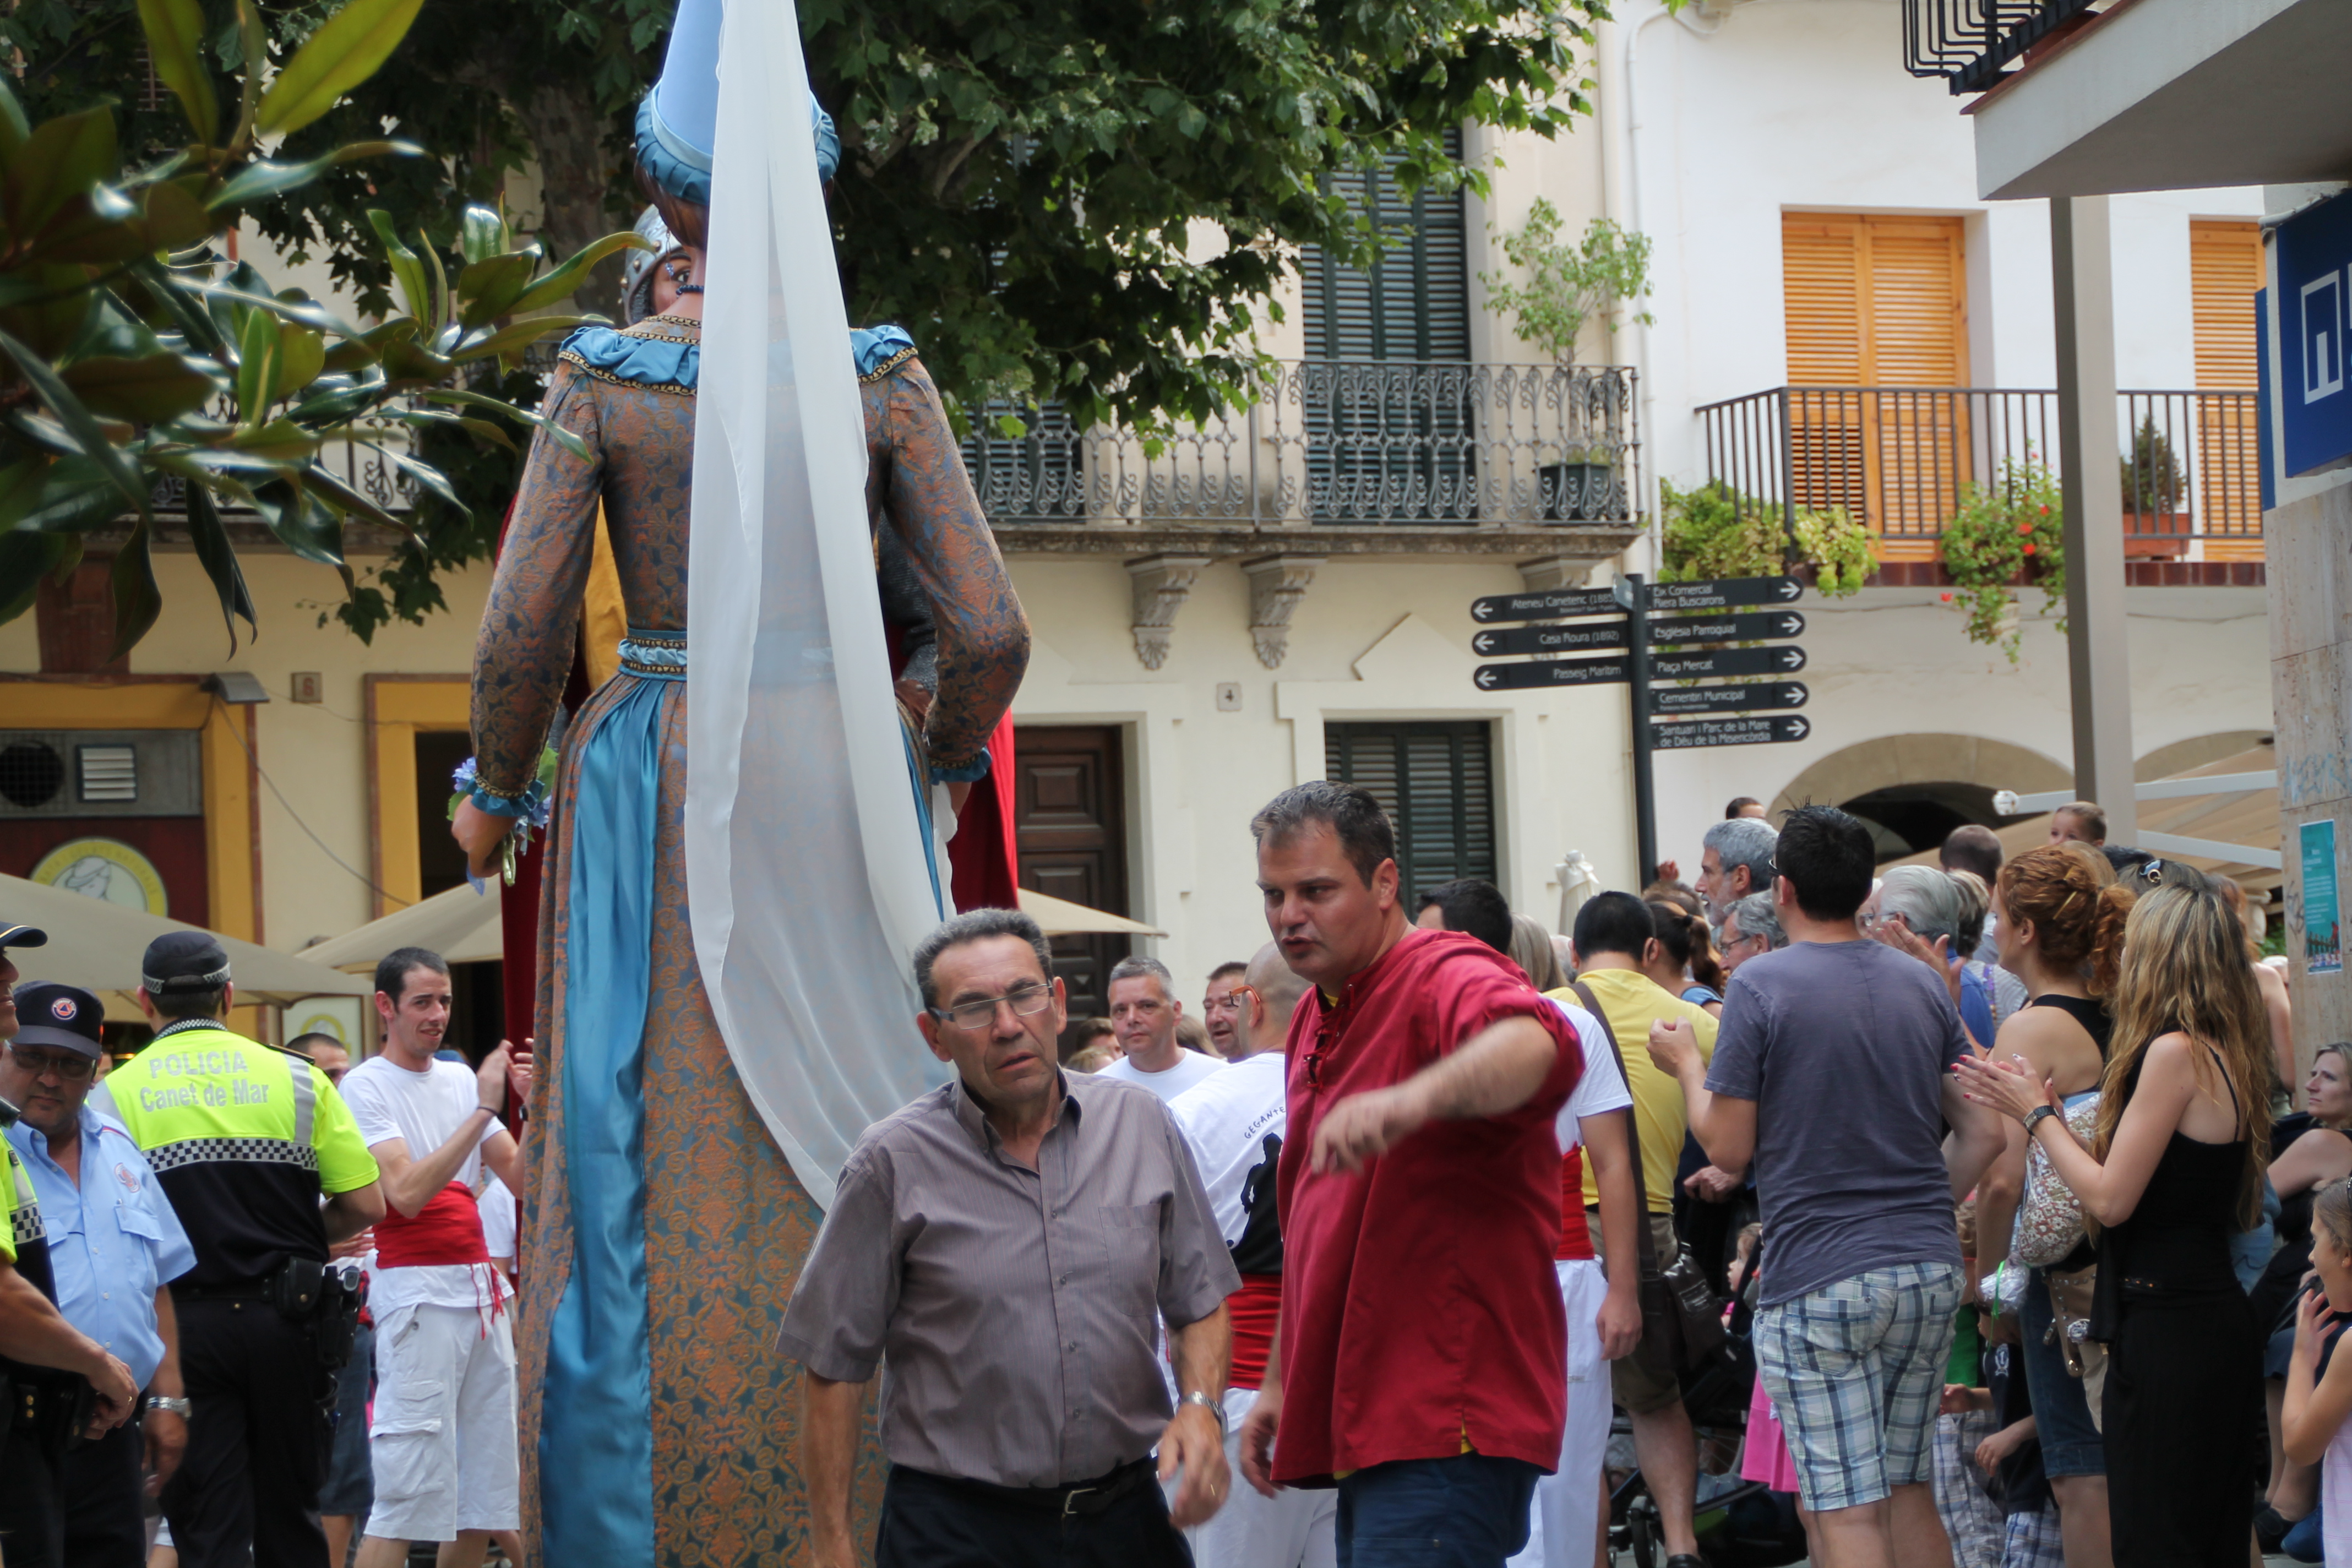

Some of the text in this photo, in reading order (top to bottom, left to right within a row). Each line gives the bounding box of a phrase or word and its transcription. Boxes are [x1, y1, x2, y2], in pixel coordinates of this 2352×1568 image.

[1653, 584, 1713, 597] Eix Comercial
[1512, 599, 1544, 608] Ateneu
[1545, 596, 1587, 606] Canetenc
[1653, 596, 1726, 608] Riera Buscarons
[1539, 630, 1619, 644] Casa Roura (1892)
[1692, 624, 1736, 636] Parroquial
[1553, 668, 1588, 680] Passeig
[1657, 660, 1714, 674] Plaça Mercat
[303, 677, 315, 696] 6
[1224, 689, 1235, 702] 4
[1659, 690, 1745, 704] Cementiri Municipal
[1659, 725, 1696, 736] Santuari
[1703, 722, 1723, 733] Parc
[1724, 722, 1736, 732] de
[1738, 721, 1746, 731] la
[1748, 720, 1771, 731] Mare
[1660, 737, 1672, 747] de
[1695, 734, 1707, 745] de
[1709, 733, 1717, 744] la
[149, 1051, 249, 1079] POLICIA
[140, 1078, 269, 1112] Canet de Mar
